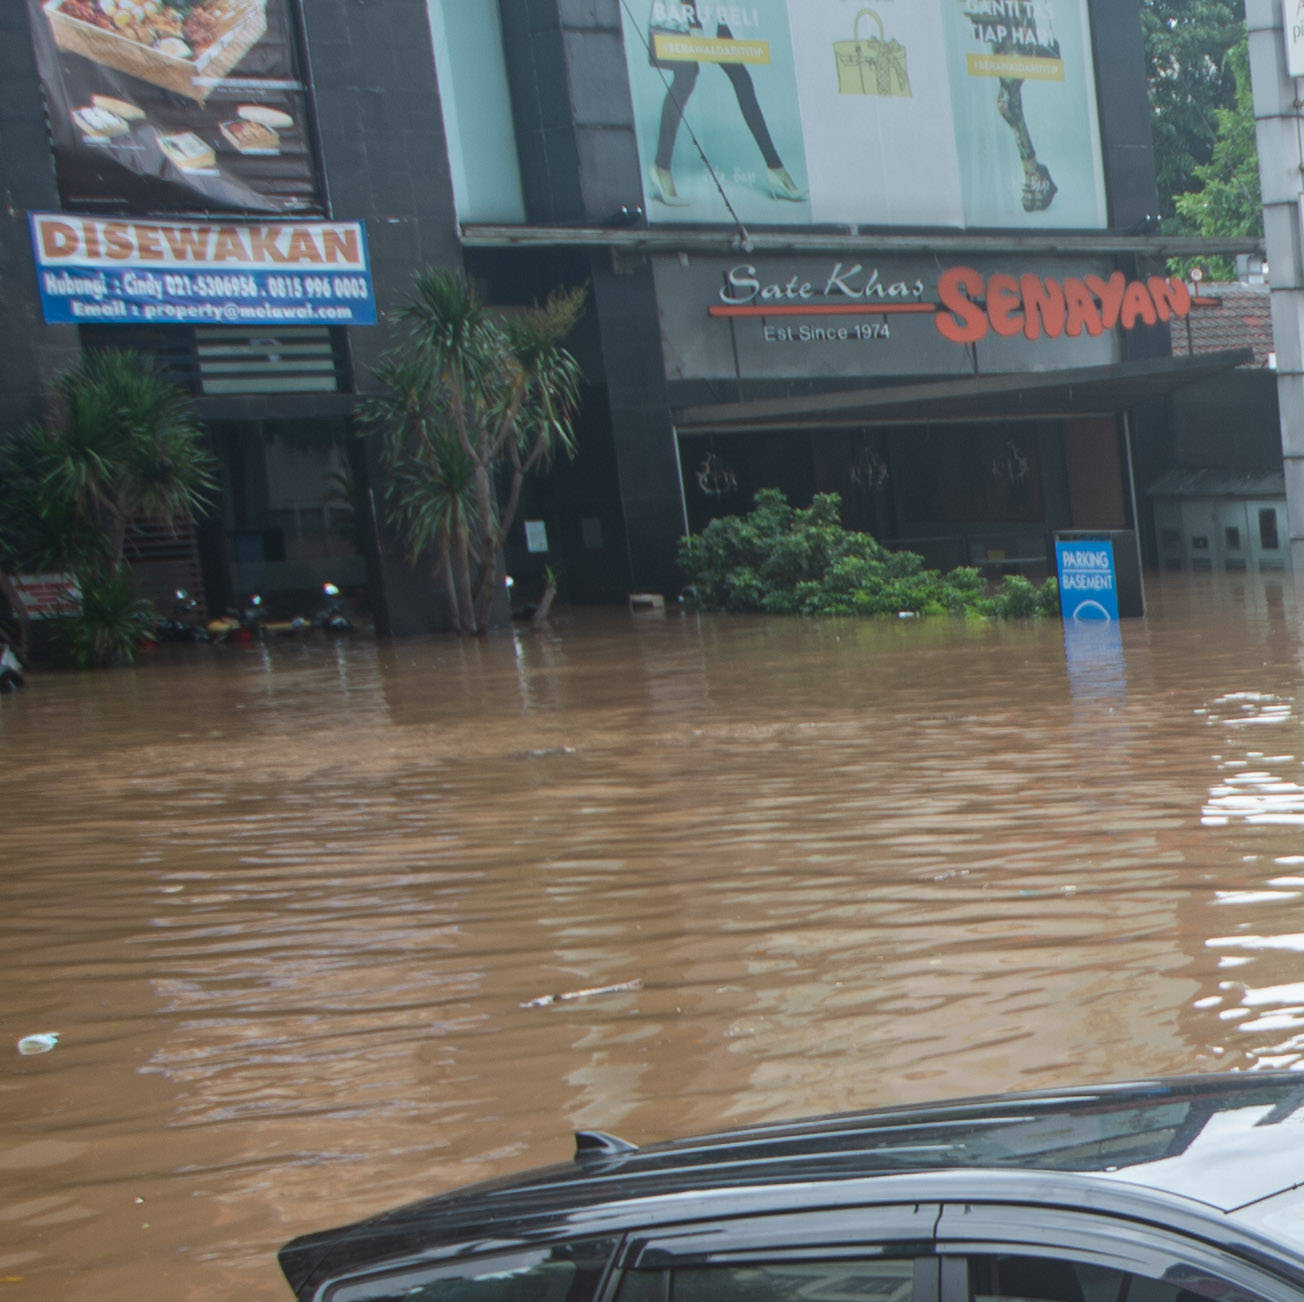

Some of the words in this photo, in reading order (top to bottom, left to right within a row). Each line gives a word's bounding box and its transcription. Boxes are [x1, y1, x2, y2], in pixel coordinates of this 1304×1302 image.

[716, 6, 761, 26] BELI
[969, 23, 1007, 43] TIAP
[39, 221, 361, 263] DISEWAKAN
[43, 271, 108, 300] Hubungi
[123, 271, 163, 299] Cindy
[164, 273, 258, 298] 021-5306956
[268, 275, 303, 298] 0815
[304, 276, 333, 299] 996
[333, 277, 368, 300] 0003
[719, 264, 813, 304] Sate
[823, 262, 924, 299] Khas
[71, 299, 127, 317] Email
[934, 265, 1191, 344] SENAYAN
[763, 325, 793, 342] Est
[799, 324, 849, 341] Since
[854, 323, 890, 340] 1974
[1062, 551, 1109, 568] PARKING
[1063, 574, 1112, 590] BASEMENT
